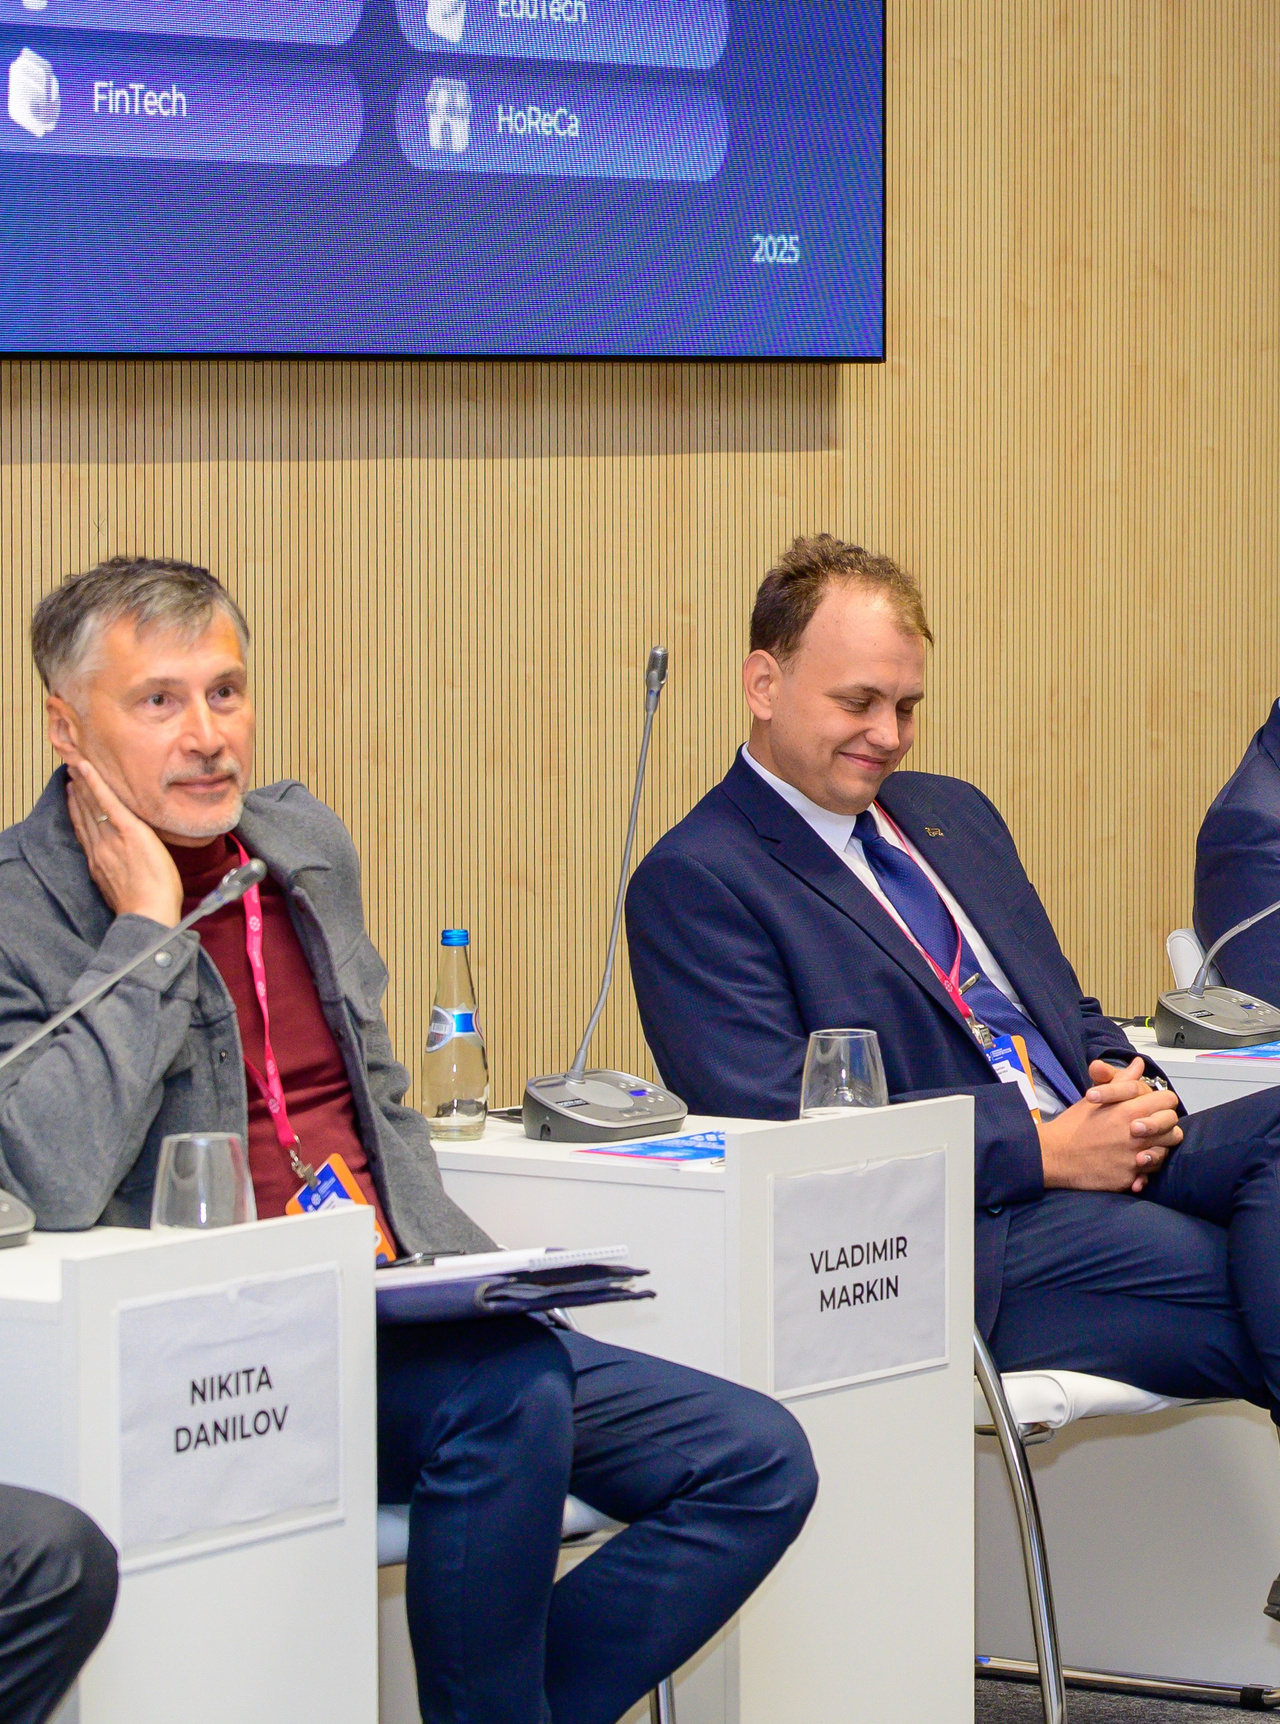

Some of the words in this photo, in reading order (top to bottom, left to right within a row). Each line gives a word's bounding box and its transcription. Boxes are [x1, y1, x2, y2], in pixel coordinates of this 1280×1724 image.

[94, 80, 188, 117] FinTech
[498, 104, 580, 137] HoReCa
[752, 233, 801, 263] 2025
[809, 1235, 908, 1275] VLADIMIR
[820, 1274, 899, 1313] MARKIN
[191, 1365, 272, 1405] NIKITA
[175, 1404, 289, 1453] DANILOV
